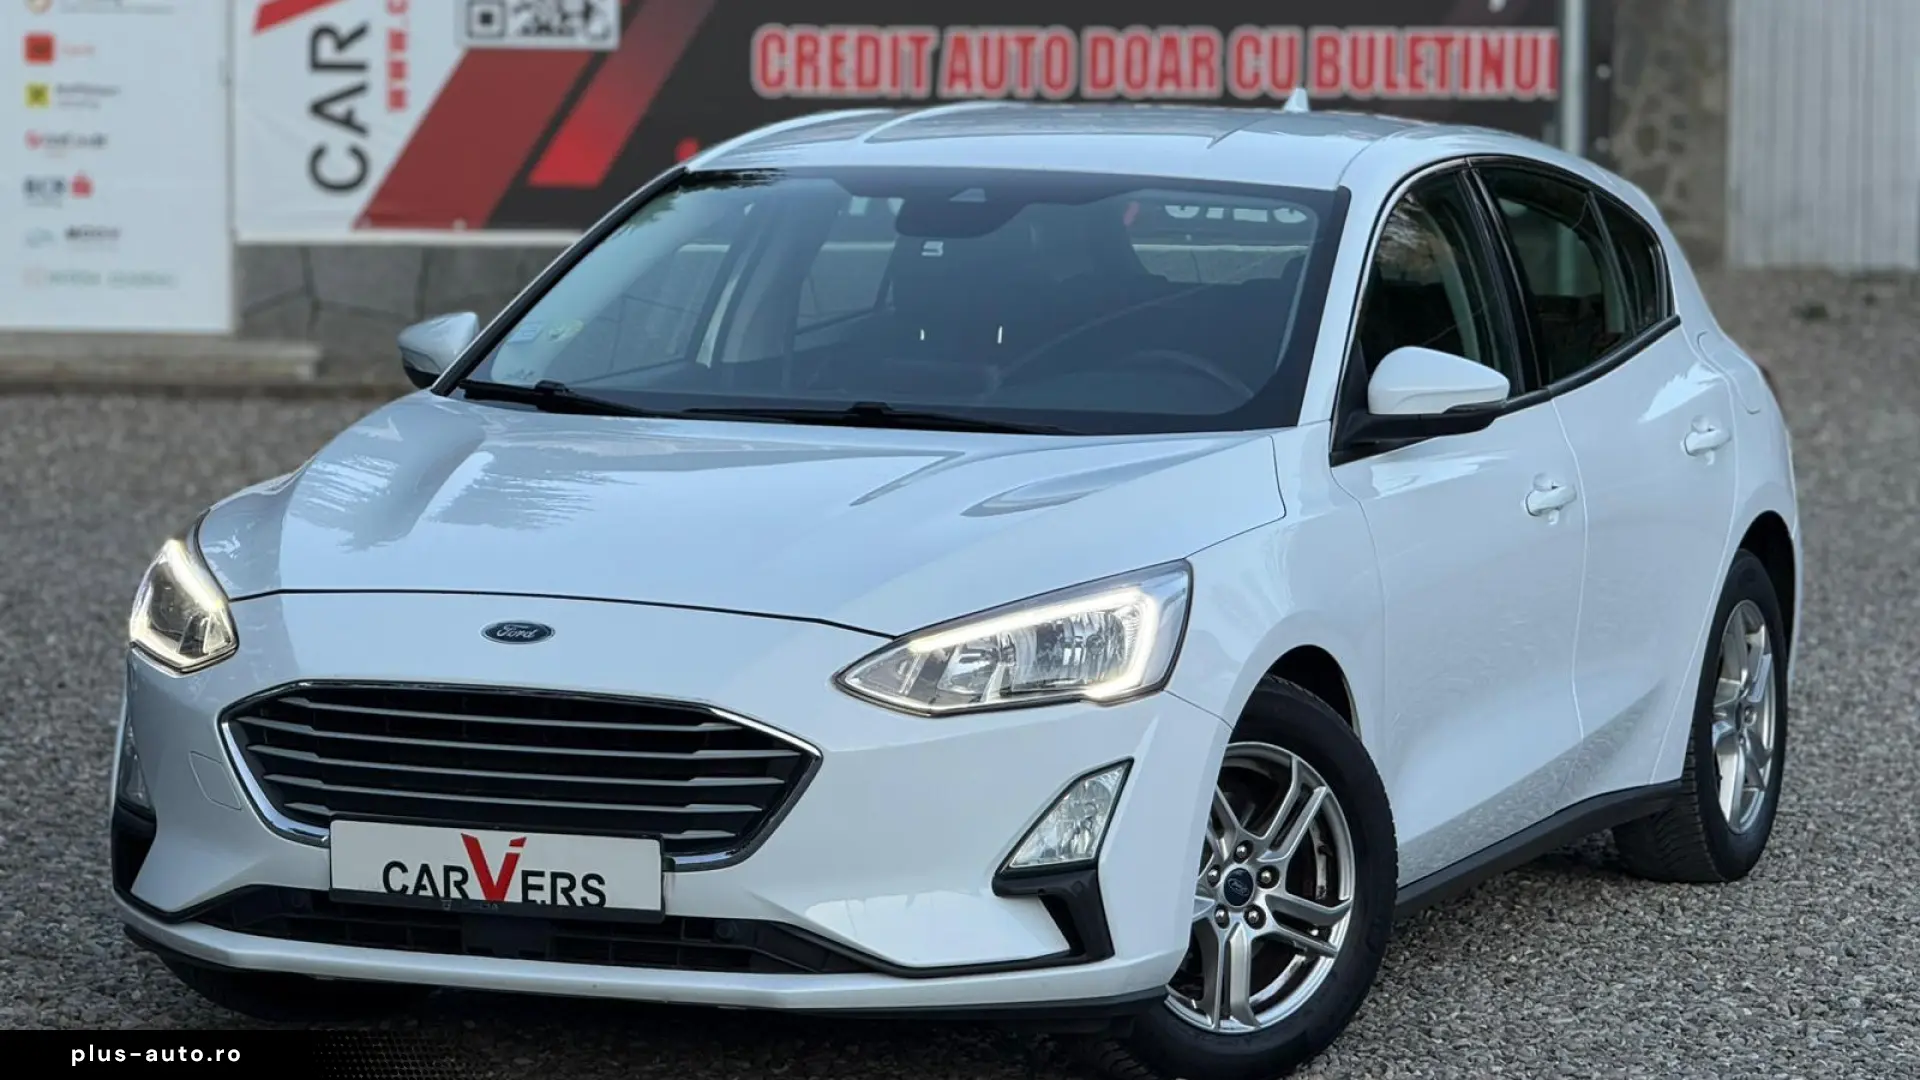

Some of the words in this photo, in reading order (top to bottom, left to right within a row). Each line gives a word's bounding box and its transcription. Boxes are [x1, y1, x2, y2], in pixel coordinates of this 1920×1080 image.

[752, 25, 938, 98] CREDIT
[939, 26, 1077, 98] AUTO
[1081, 26, 1223, 98] DOAR
[1228, 26, 1303, 98] CU
[496, 624, 538, 639] Ford
[382, 832, 607, 908] CARVERS
